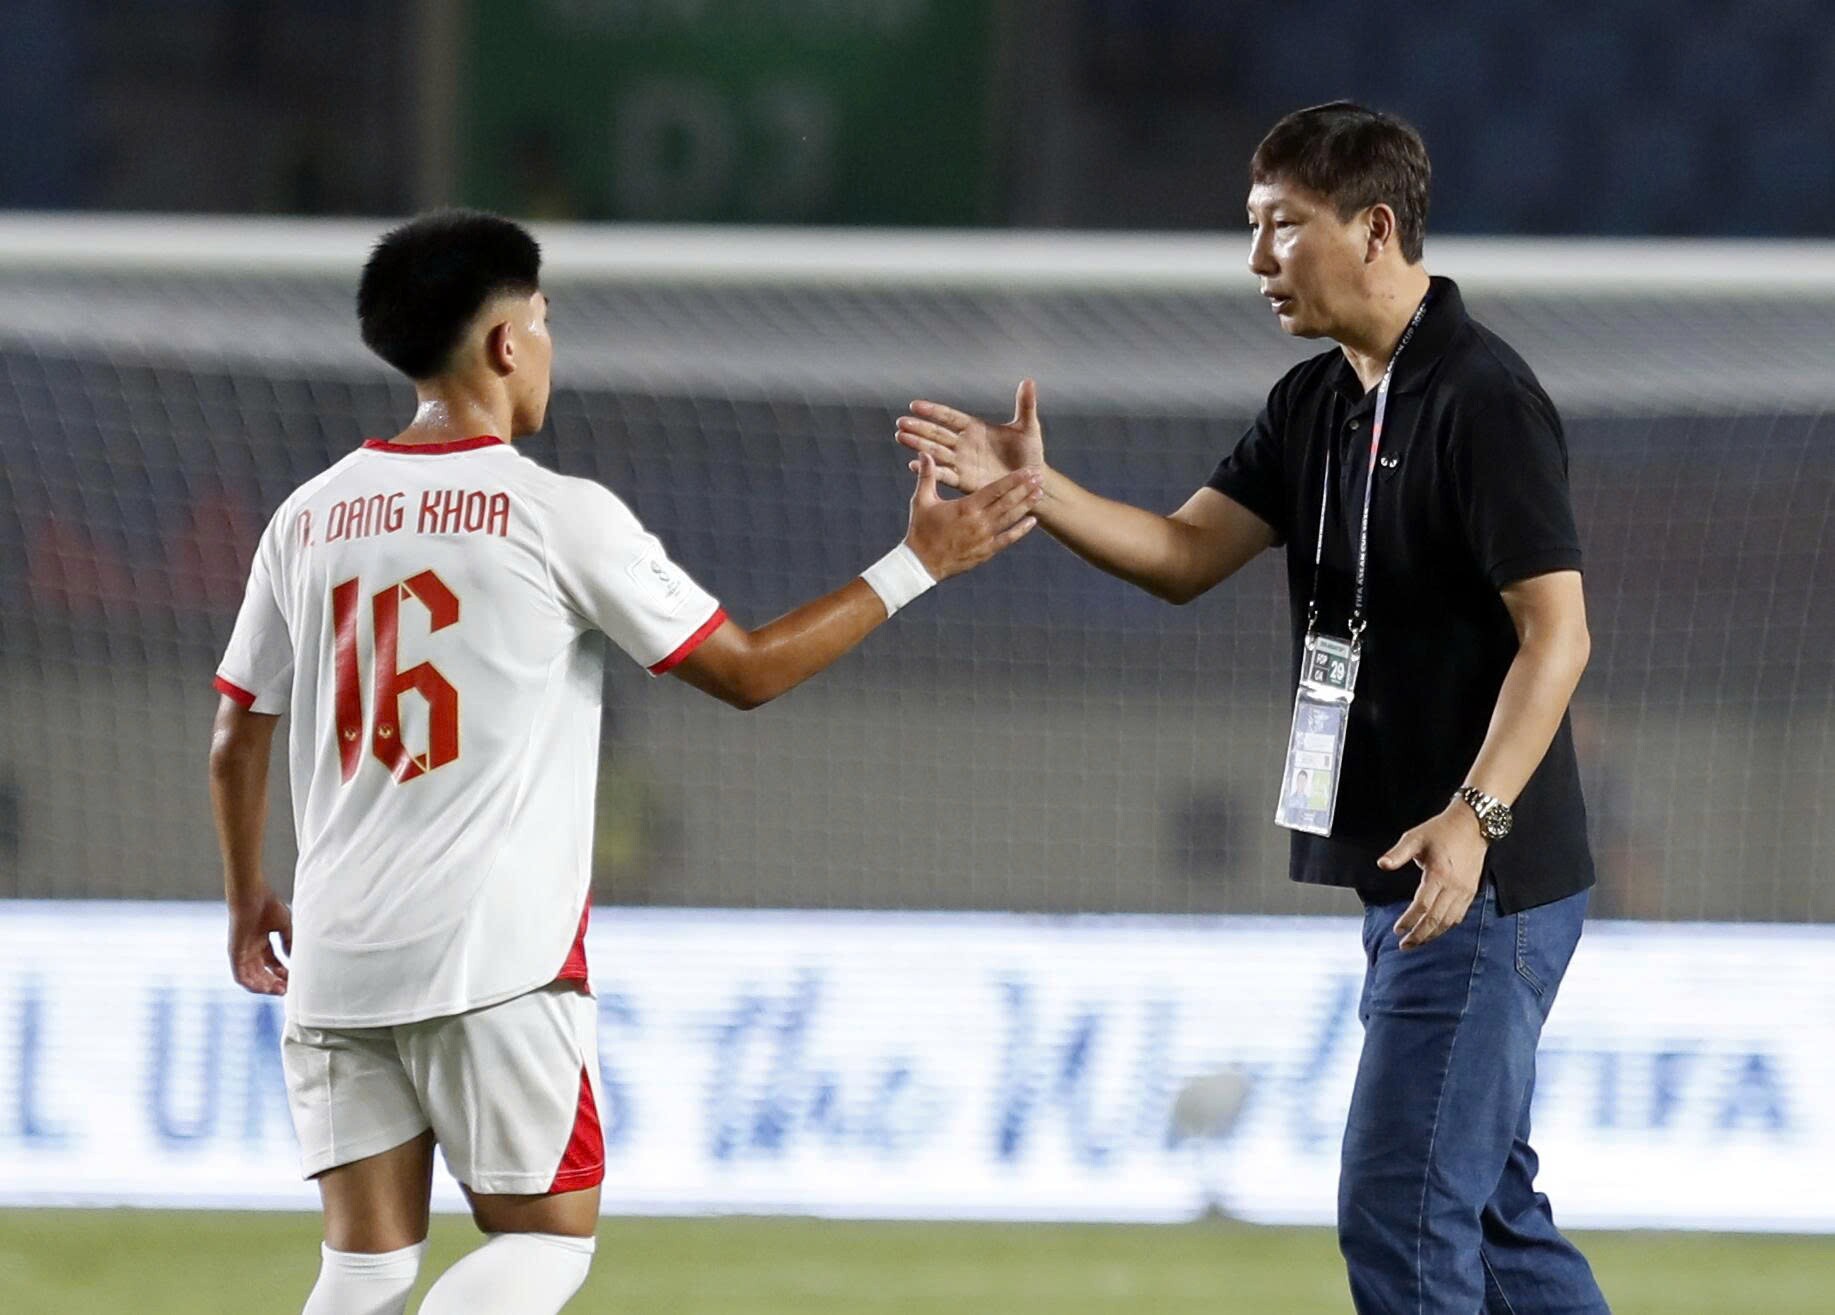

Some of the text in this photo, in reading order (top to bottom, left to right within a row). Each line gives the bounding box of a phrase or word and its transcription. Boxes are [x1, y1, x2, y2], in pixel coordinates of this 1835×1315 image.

[325, 492, 406, 544] DANG
[416, 489, 510, 537] KHOA
[331, 568, 462, 786] 16
[1329, 660, 1345, 681] 29
